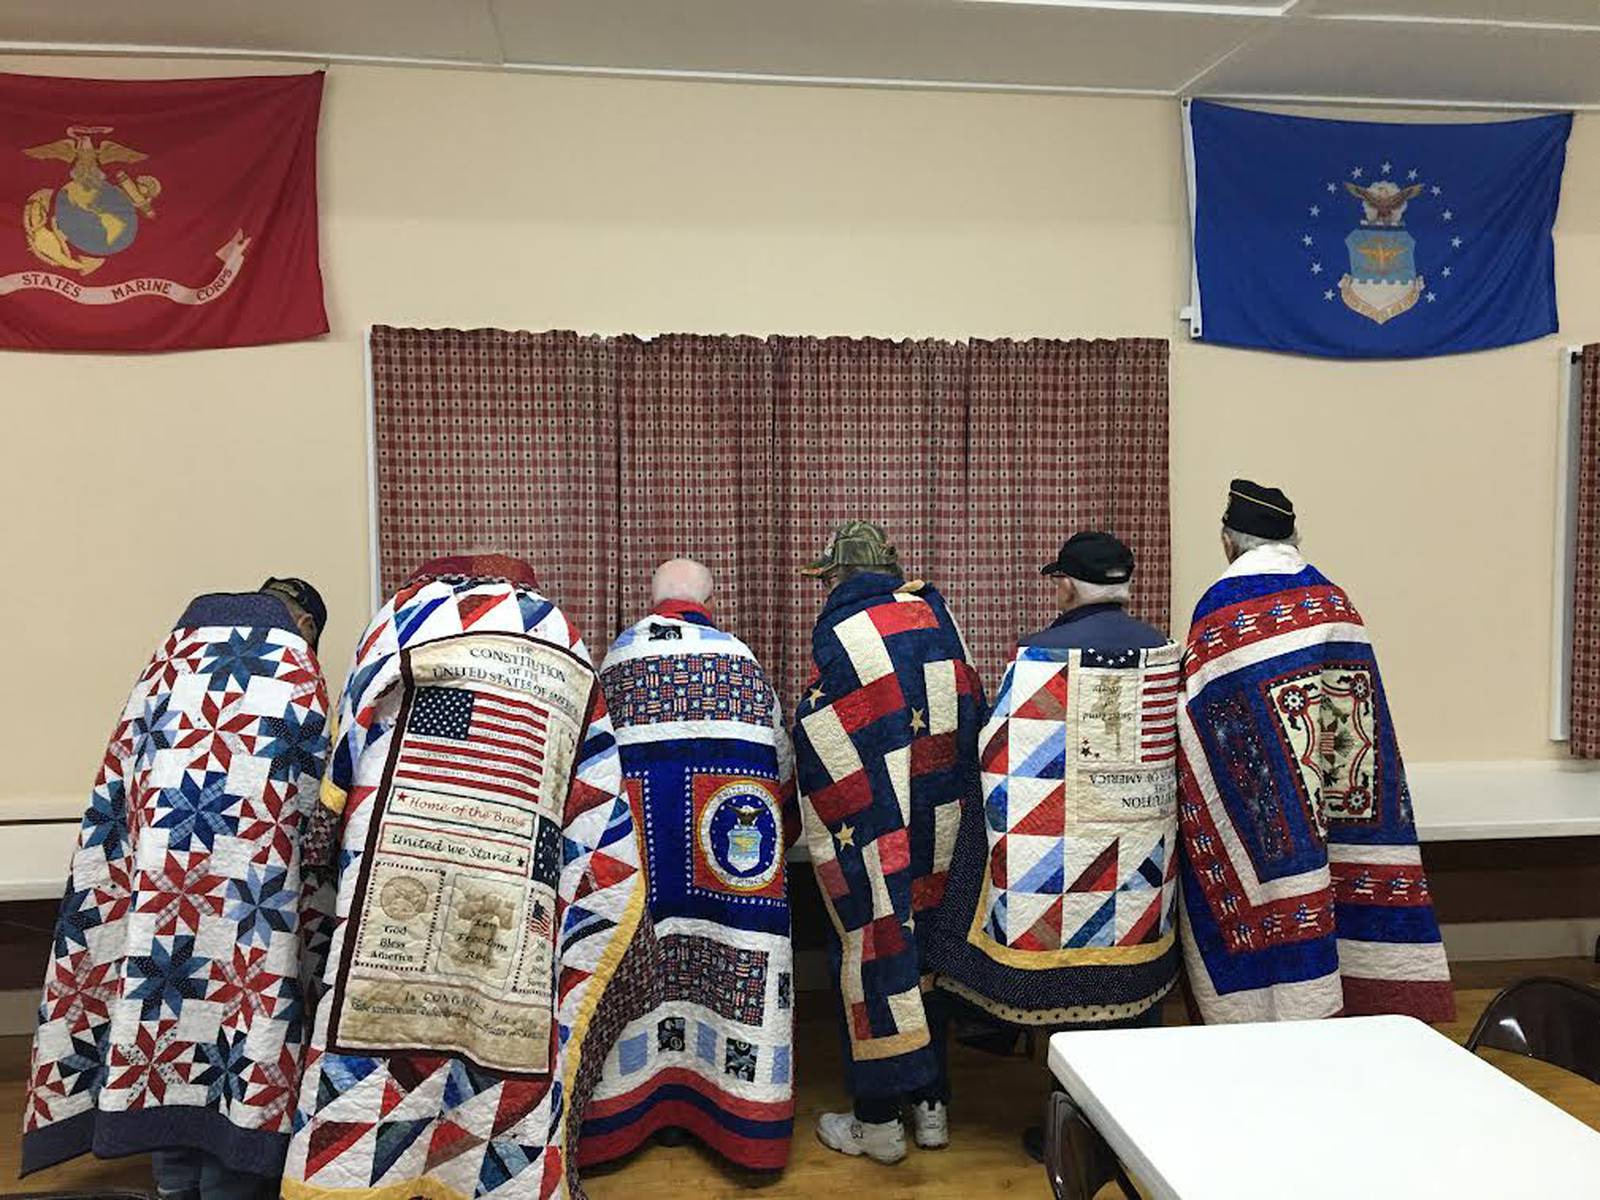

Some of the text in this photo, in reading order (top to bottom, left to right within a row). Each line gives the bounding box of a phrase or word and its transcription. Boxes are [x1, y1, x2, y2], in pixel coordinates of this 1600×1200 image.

[22, 268, 233, 302] STATES MARINE CORPS
[470, 648, 566, 683] CONSTITUTION
[432, 666, 488, 679] UNITED
[489, 671, 532, 690] STATES
[1089, 774, 1142, 785] AMERICA
[409, 796, 448, 812] Home
[451, 804, 467, 817] of
[468, 805, 491, 820] the
[392, 833, 513, 864] United we Stand
[385, 925, 407, 936] God
[380, 937, 406, 949] Bless
[370, 950, 414, 963] America
